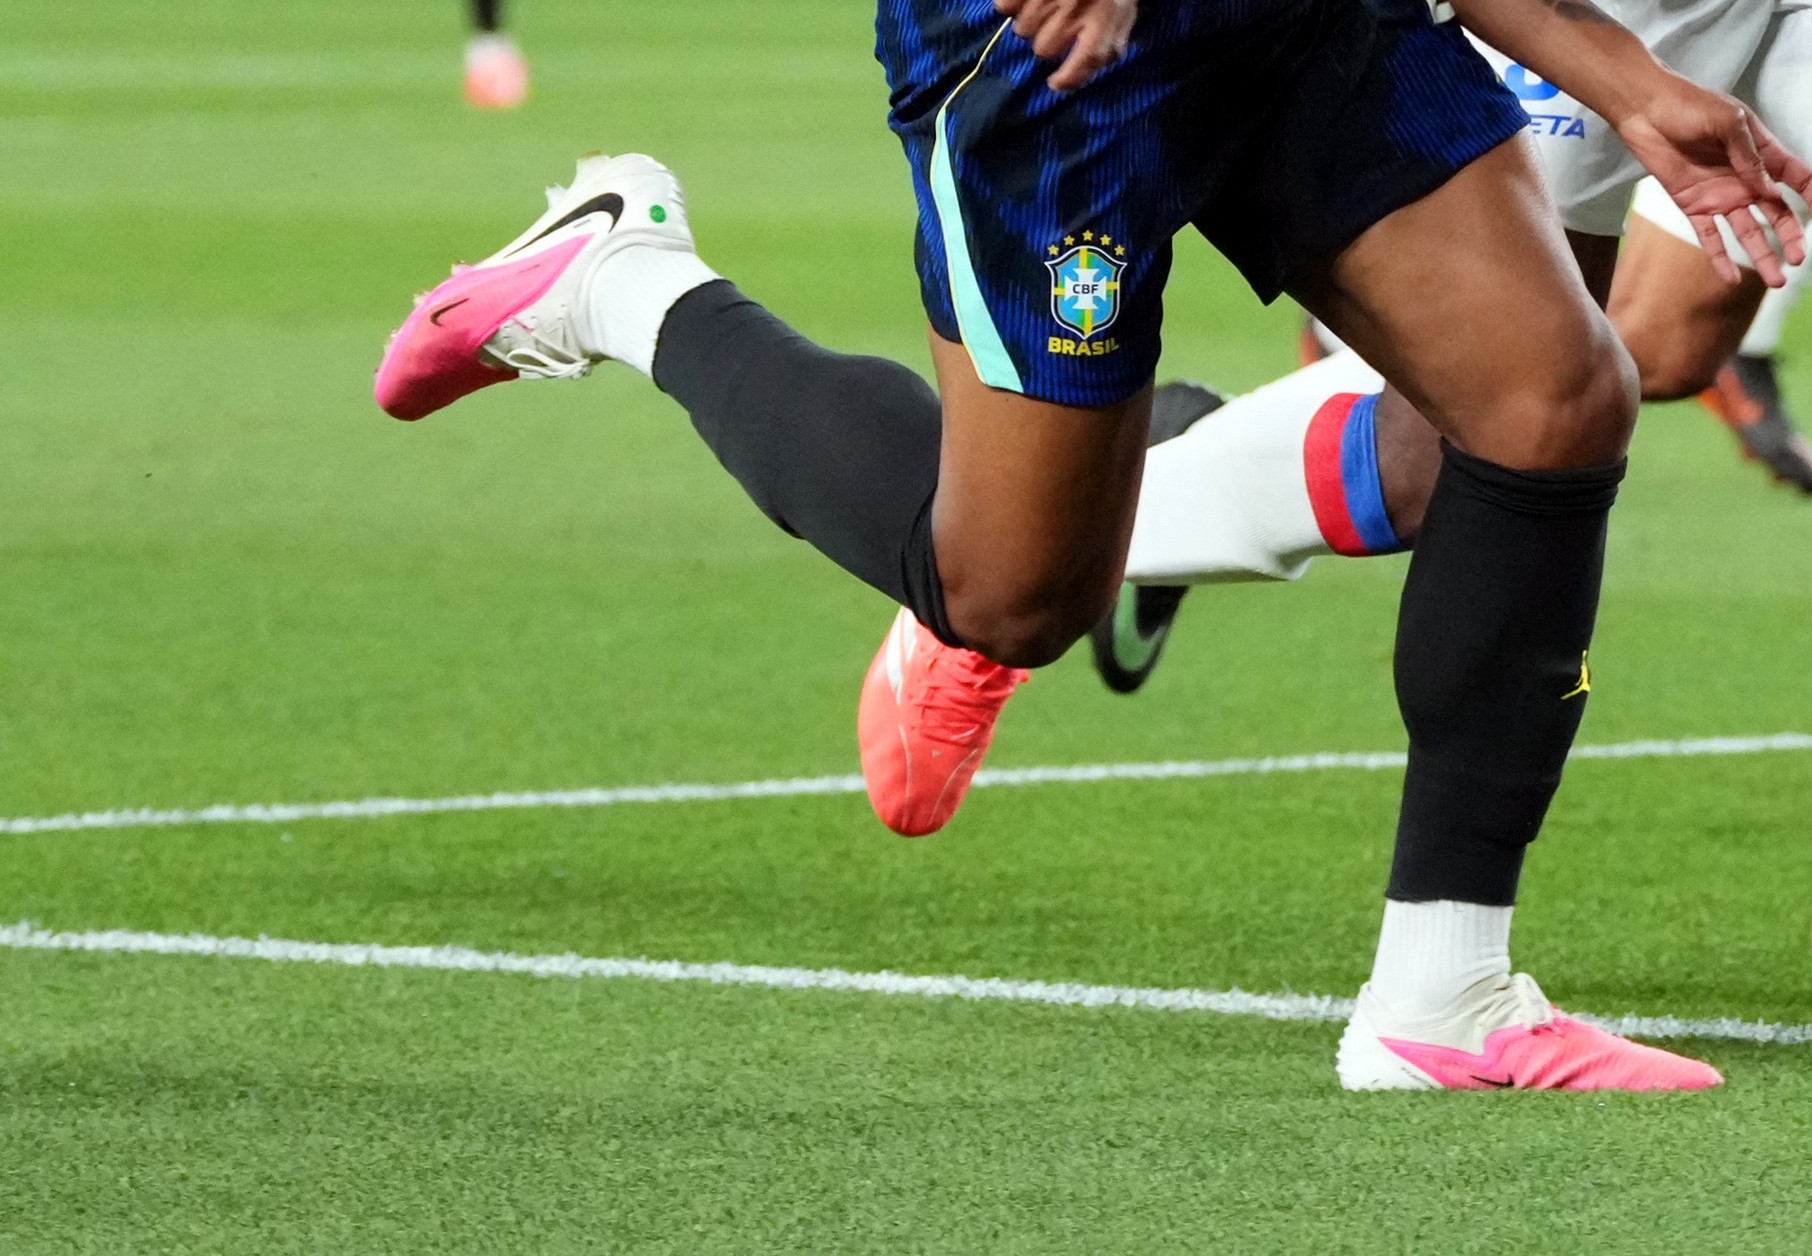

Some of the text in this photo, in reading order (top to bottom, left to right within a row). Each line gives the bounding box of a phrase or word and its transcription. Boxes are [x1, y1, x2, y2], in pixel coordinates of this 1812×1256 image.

[1529, 114, 1585, 139] ETA
[1072, 284, 1099, 294] CBF
[1048, 336, 1119, 356] BRASIL
